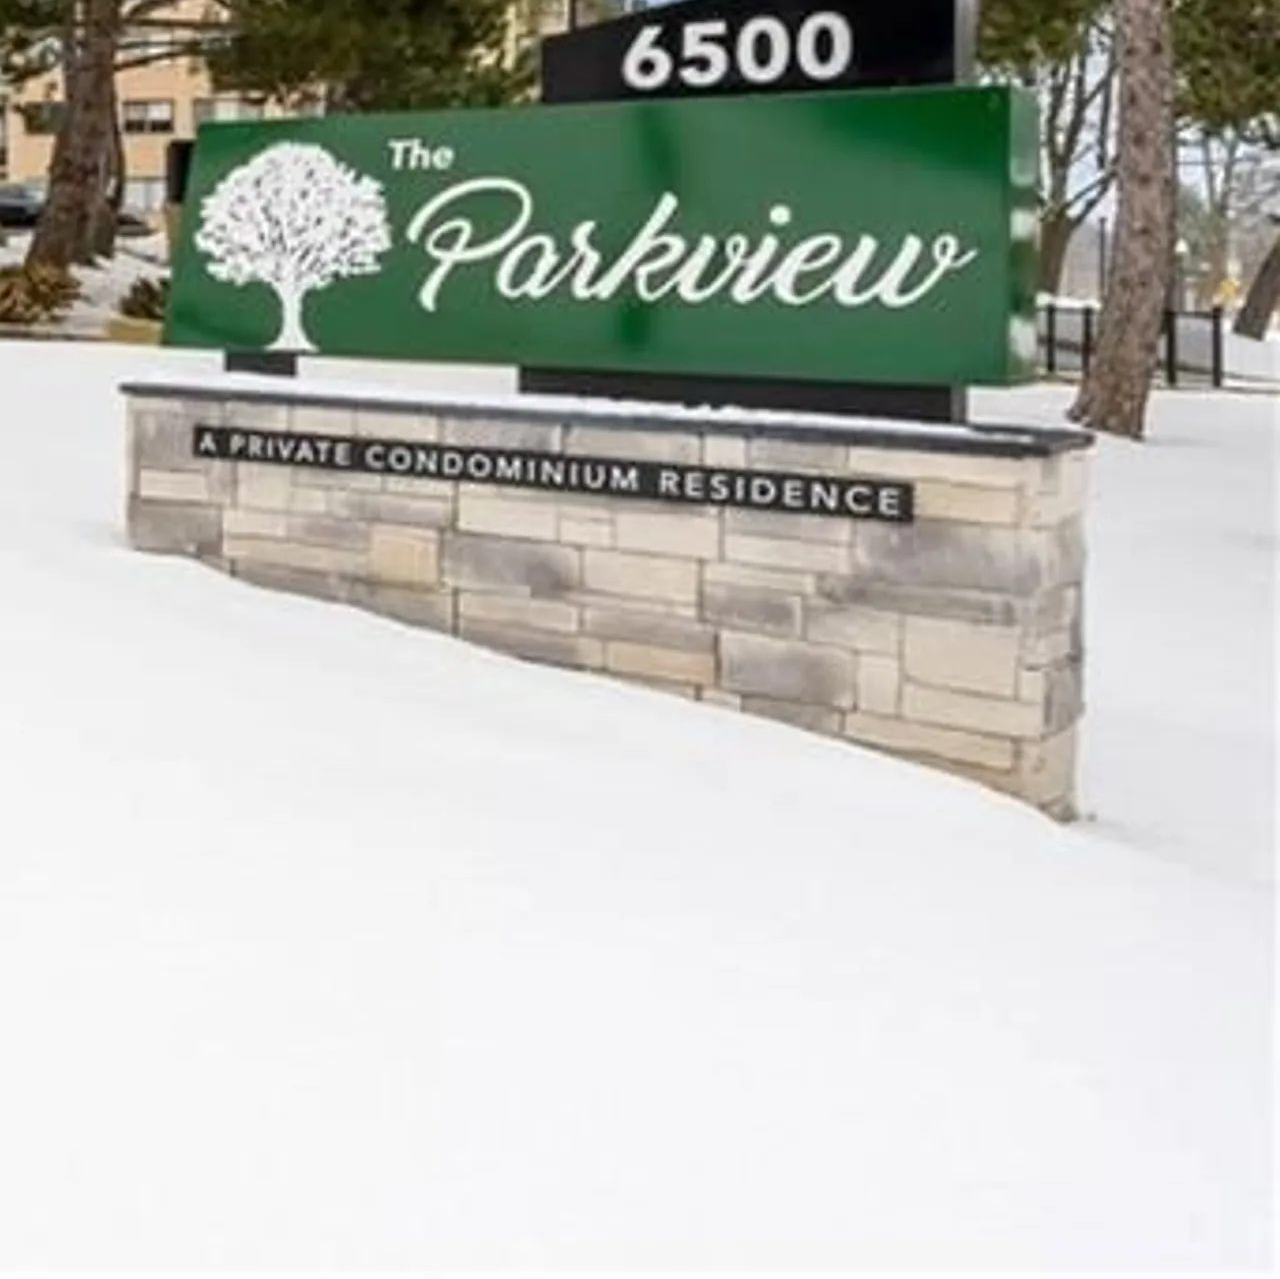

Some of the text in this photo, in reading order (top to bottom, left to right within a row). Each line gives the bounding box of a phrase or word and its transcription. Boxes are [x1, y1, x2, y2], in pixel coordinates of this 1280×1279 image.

[621, 10, 853, 90] 6500
[388, 138, 453, 172] The
[406, 176, 977, 314] Parkview
[198, 434, 902, 517] A PRIVATE CONDOMINIUM RESIDENCE
